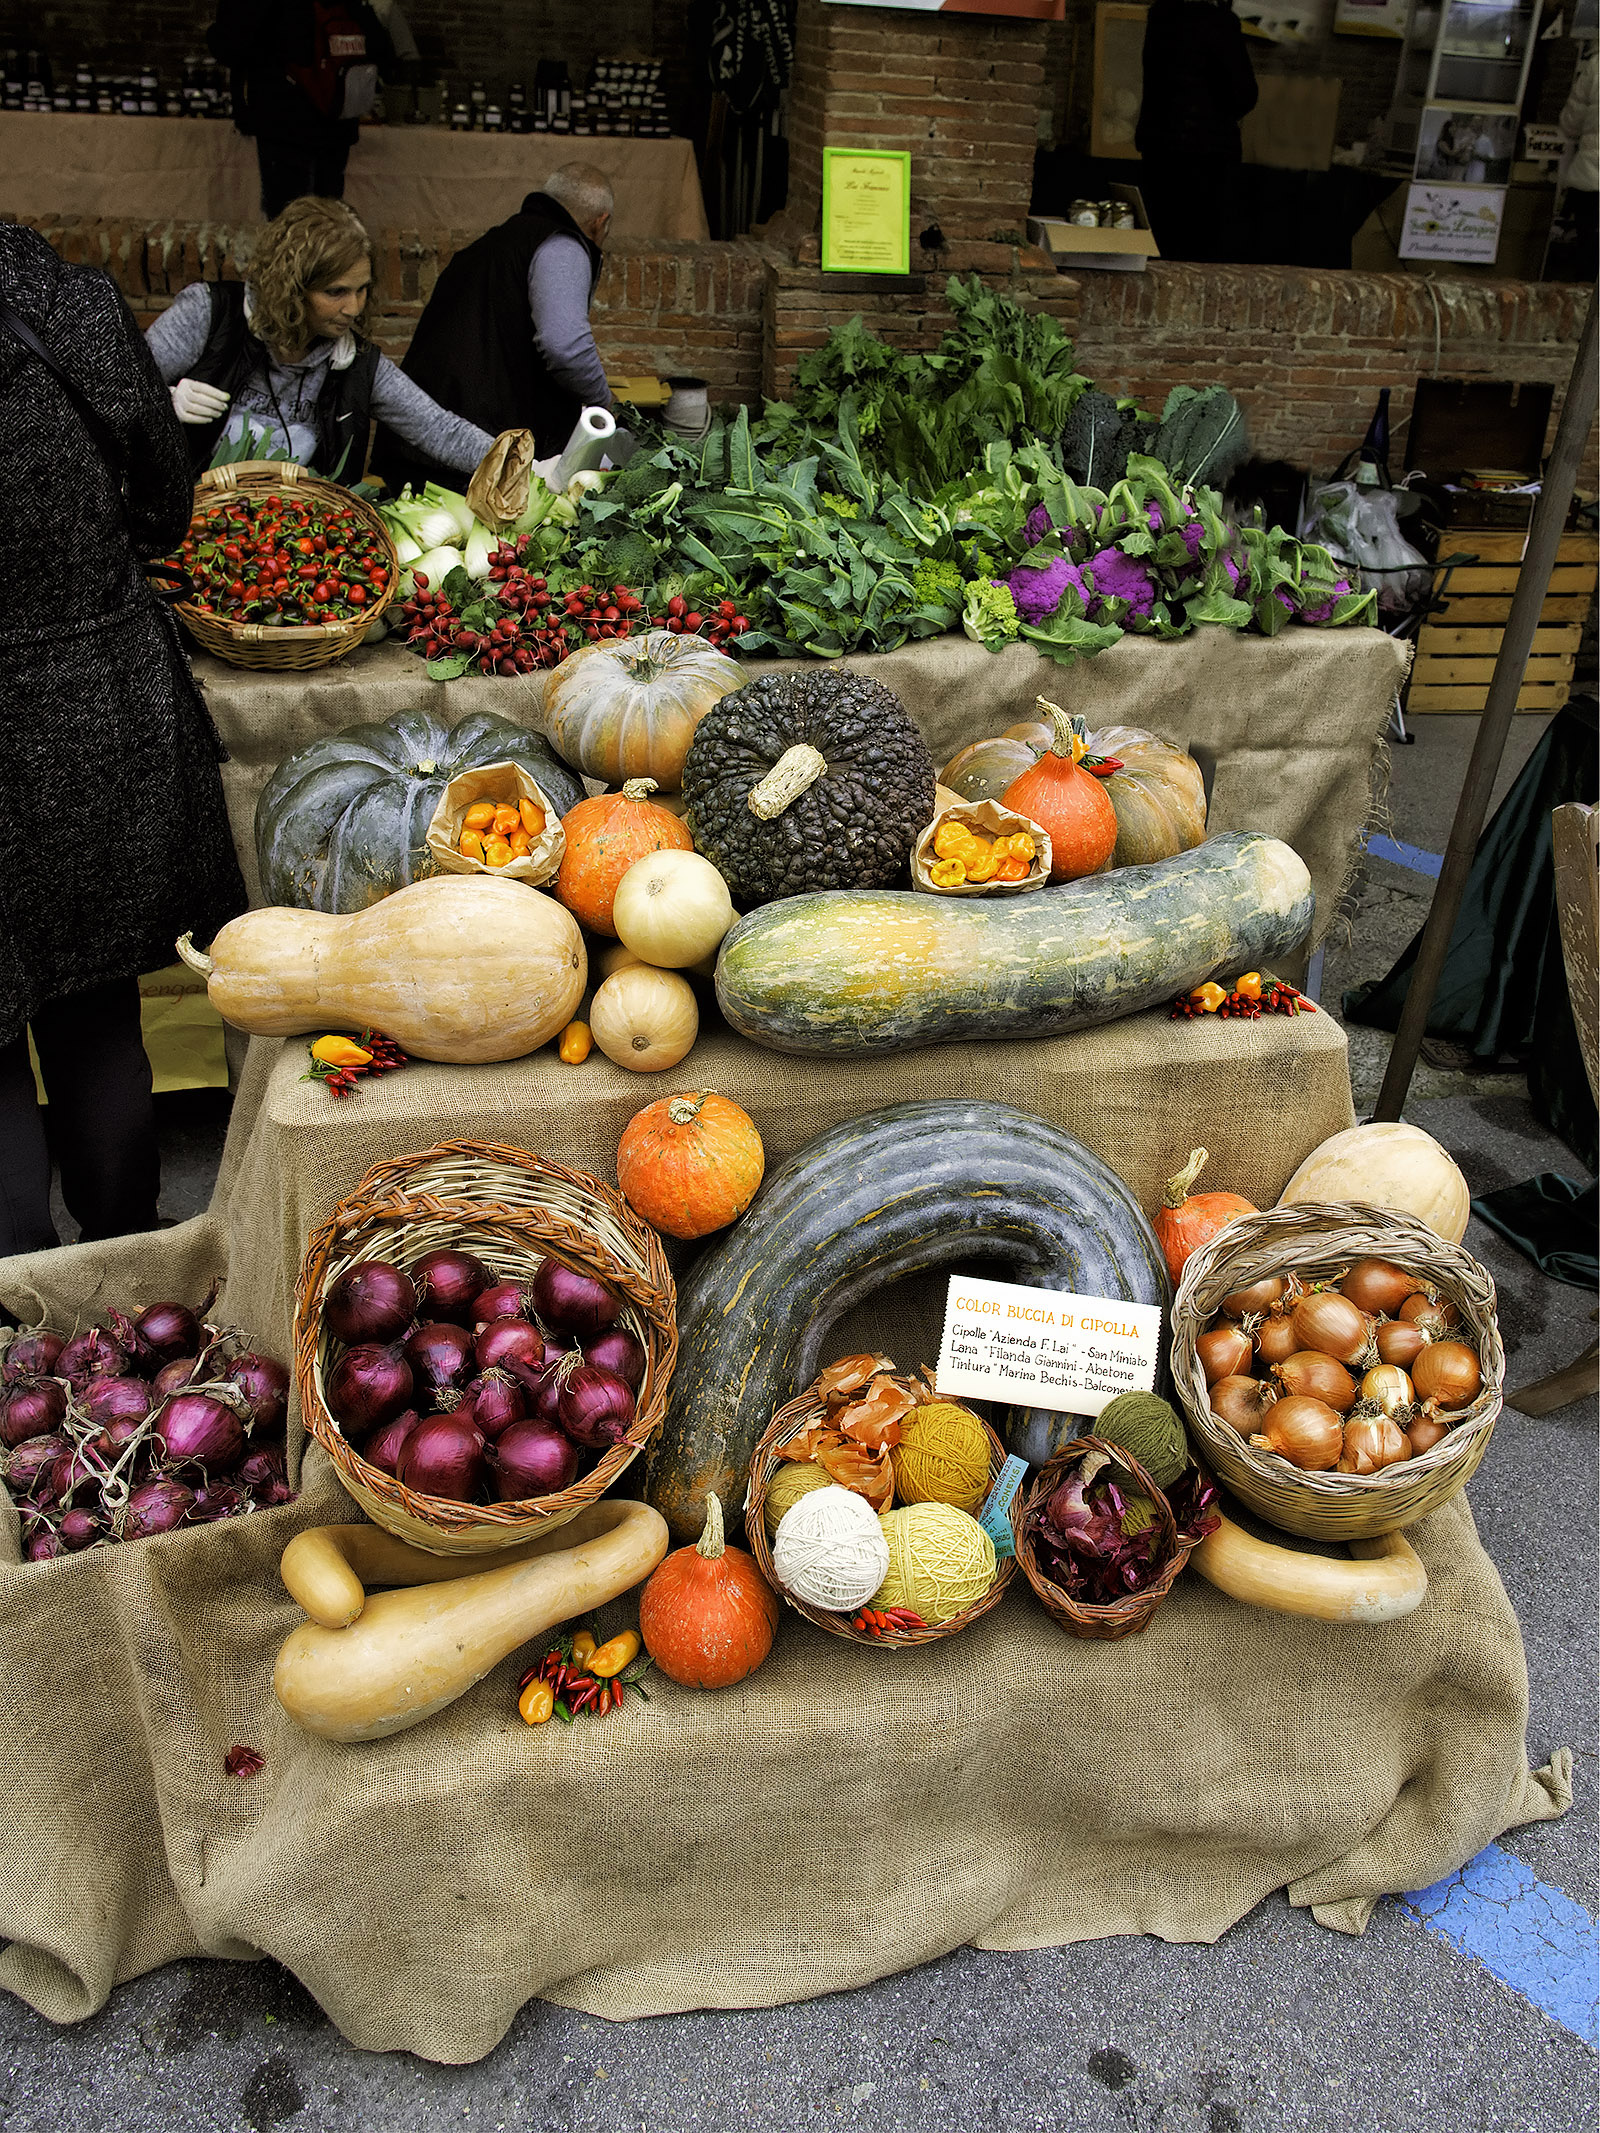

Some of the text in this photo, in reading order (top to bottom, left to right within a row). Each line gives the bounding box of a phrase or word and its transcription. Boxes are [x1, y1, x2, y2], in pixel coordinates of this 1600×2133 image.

[956, 1296, 1139, 1338] COLOR BUCCIA DI CIPOLLA
[949, 1355, 991, 1374] Tintura
[951, 1339, 978, 1355] Lana
[1034, 1353, 1077, 1372] Giannini
[1085, 1362, 1135, 1381] Abetone
[952, 1323, 987, 1340] Cipolle
[1040, 1338, 1050, 1351] F.
[1109, 1349, 1148, 1367] Miniato
